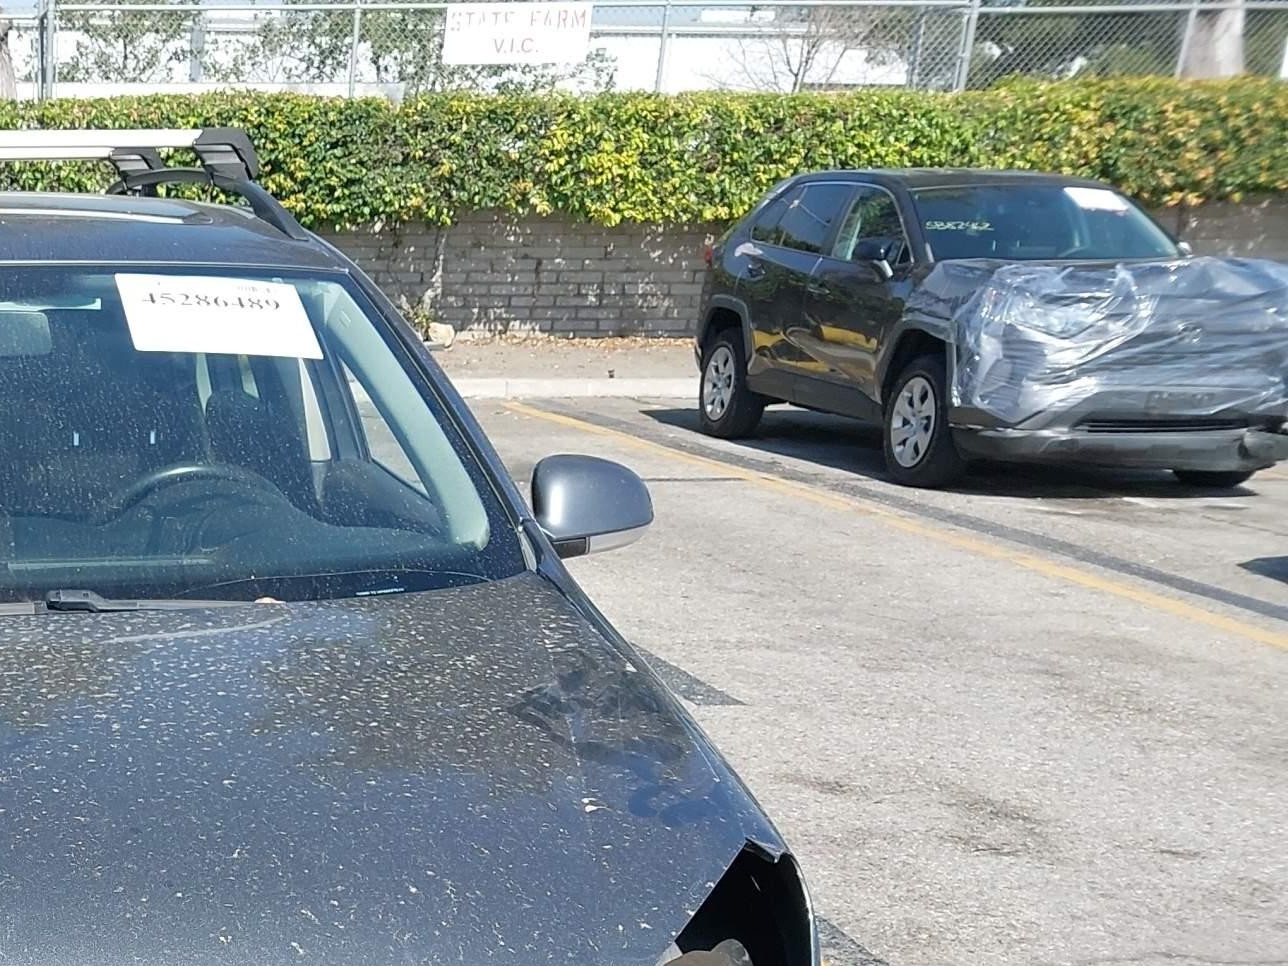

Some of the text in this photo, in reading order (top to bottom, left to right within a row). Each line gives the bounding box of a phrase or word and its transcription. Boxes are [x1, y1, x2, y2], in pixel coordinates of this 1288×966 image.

[529, 8, 587, 29] FARM
[493, 37, 539, 54] V.I.C.
[141, 292, 281, 310] 45286489
